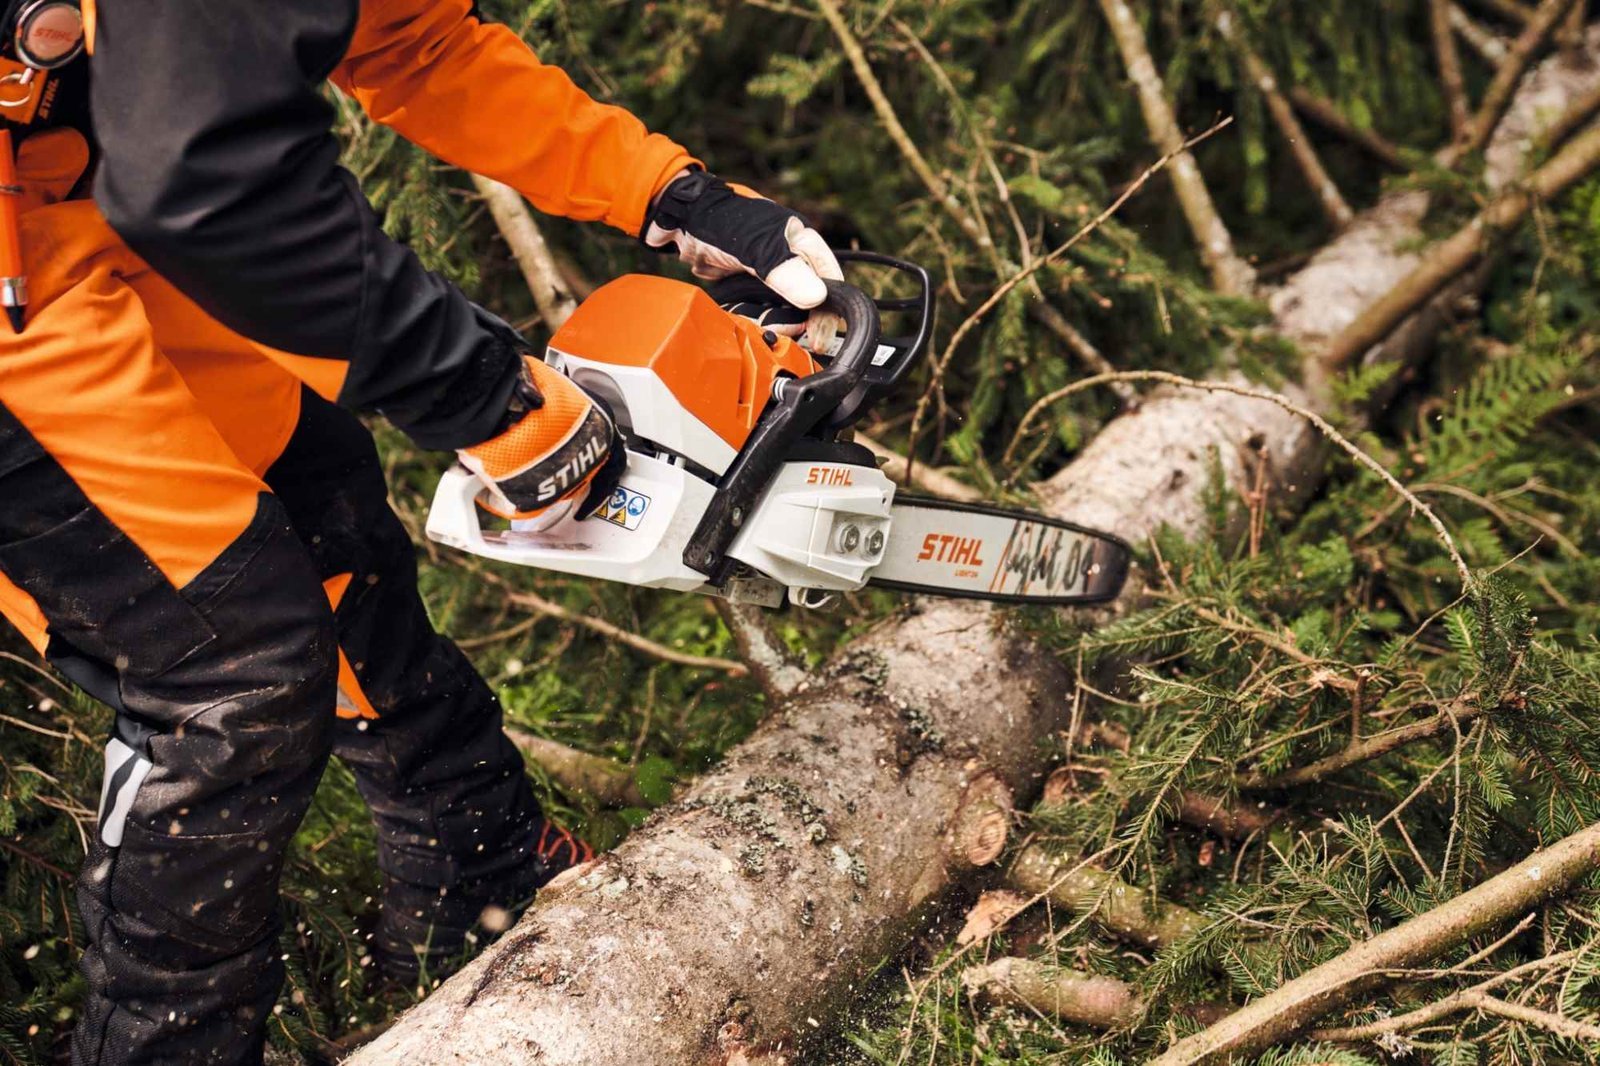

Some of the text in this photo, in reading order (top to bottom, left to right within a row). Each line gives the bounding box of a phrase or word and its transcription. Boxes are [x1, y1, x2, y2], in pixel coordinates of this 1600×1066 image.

[34, 28, 75, 42] STIHL
[39, 78, 59, 119] STIHL
[538, 437, 607, 502] STIHL
[807, 467, 853, 486] STIHL
[918, 533, 983, 566] STIHL
